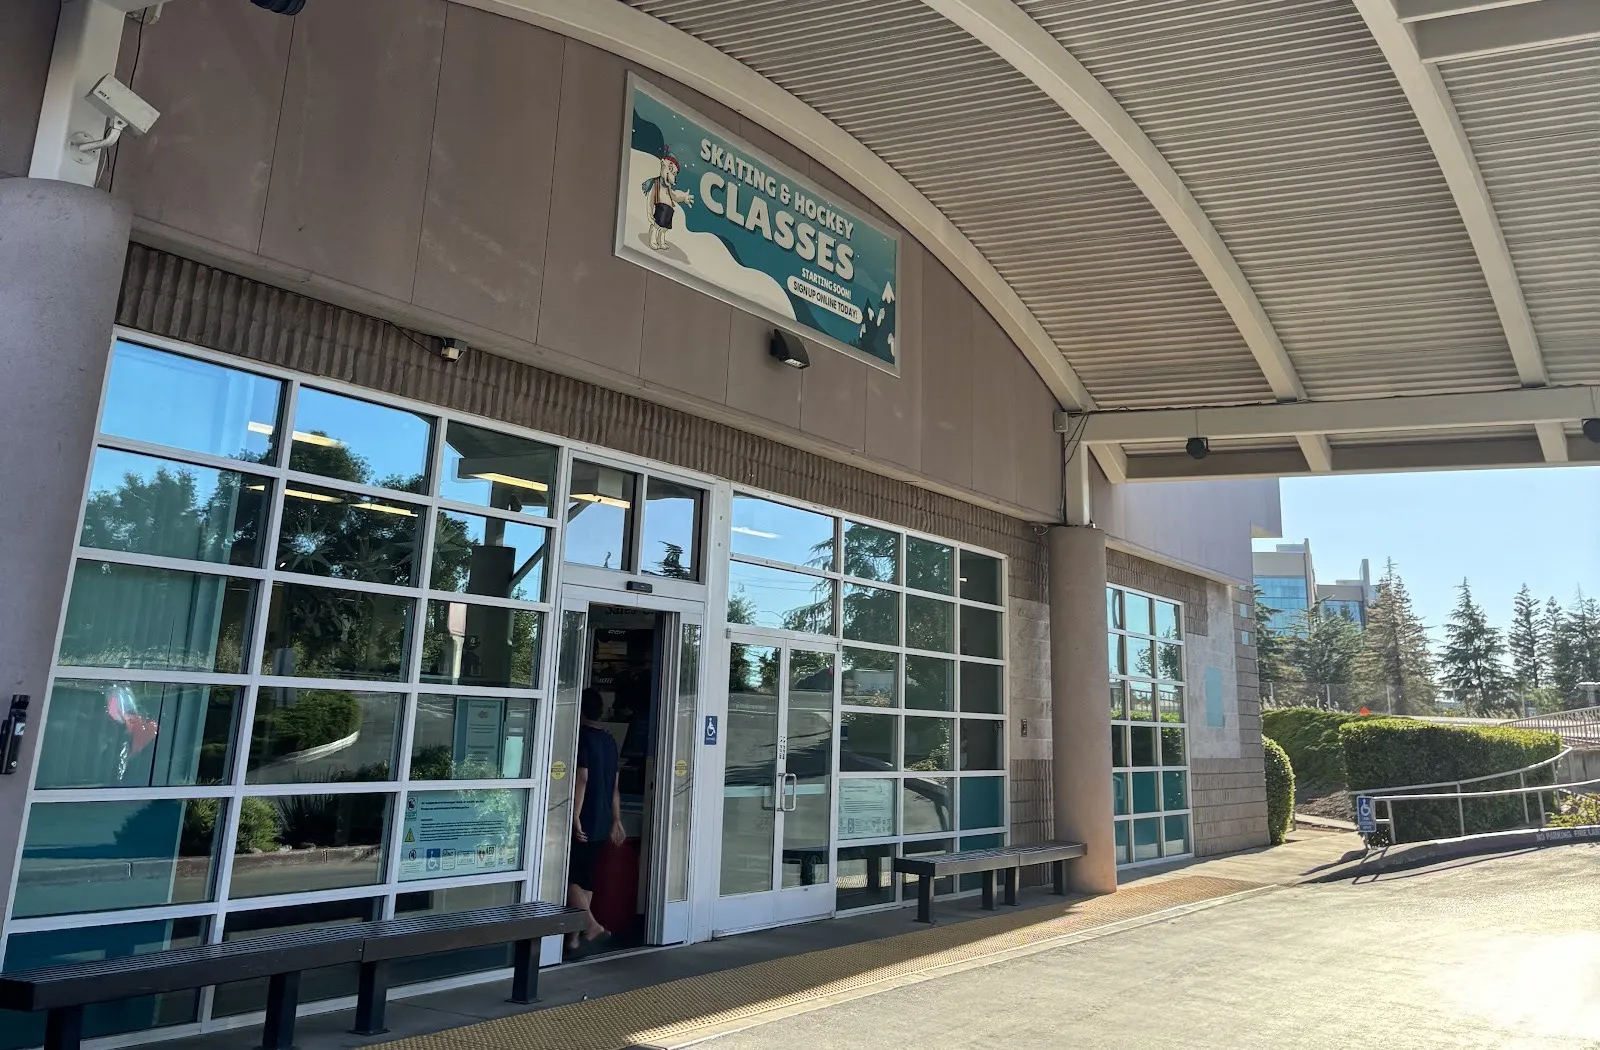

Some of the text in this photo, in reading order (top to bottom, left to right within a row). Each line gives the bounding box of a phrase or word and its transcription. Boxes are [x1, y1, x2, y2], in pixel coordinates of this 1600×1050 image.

[700, 138, 853, 240] SKATING & HOCKEY
[700, 171, 854, 281] CLASSES
[793, 281, 858, 320] SIGN UP ONLINE TODAY!
[801, 267, 852, 300] STARTING SOON!
[1536, 833, 1545, 841] NO
[1546, 831, 1572, 840] PARKING
